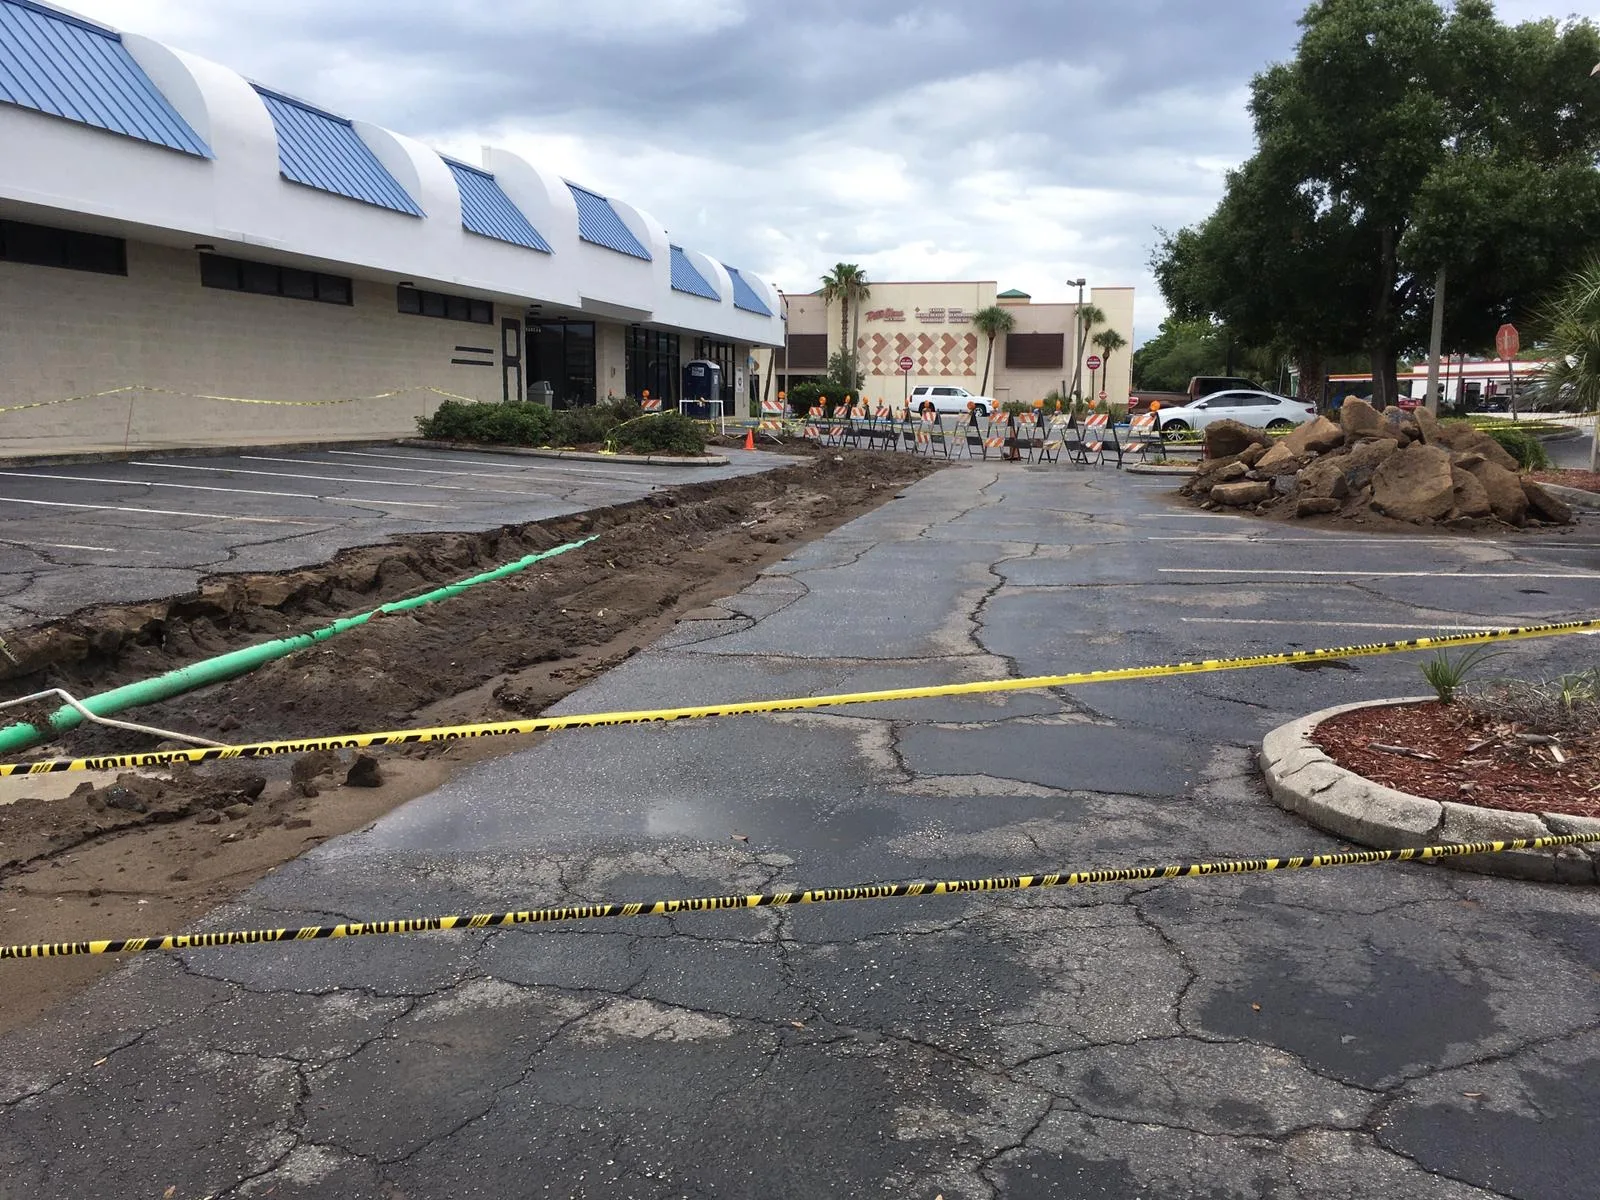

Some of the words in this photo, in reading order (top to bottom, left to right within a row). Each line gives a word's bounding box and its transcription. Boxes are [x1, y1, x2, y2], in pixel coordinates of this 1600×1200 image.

[172, 929, 277, 948] CUIDADO
[345, 917, 441, 936] CAUTION
[513, 905, 606, 923] CUIDADO
[664, 896, 747, 912] CAUTION
[811, 885, 894, 902] CUIDADO
[945, 877, 1019, 893] CAUTION
[1077, 868, 1152, 883] CUIDADO
[1199, 860, 1267, 875] CAUTION
